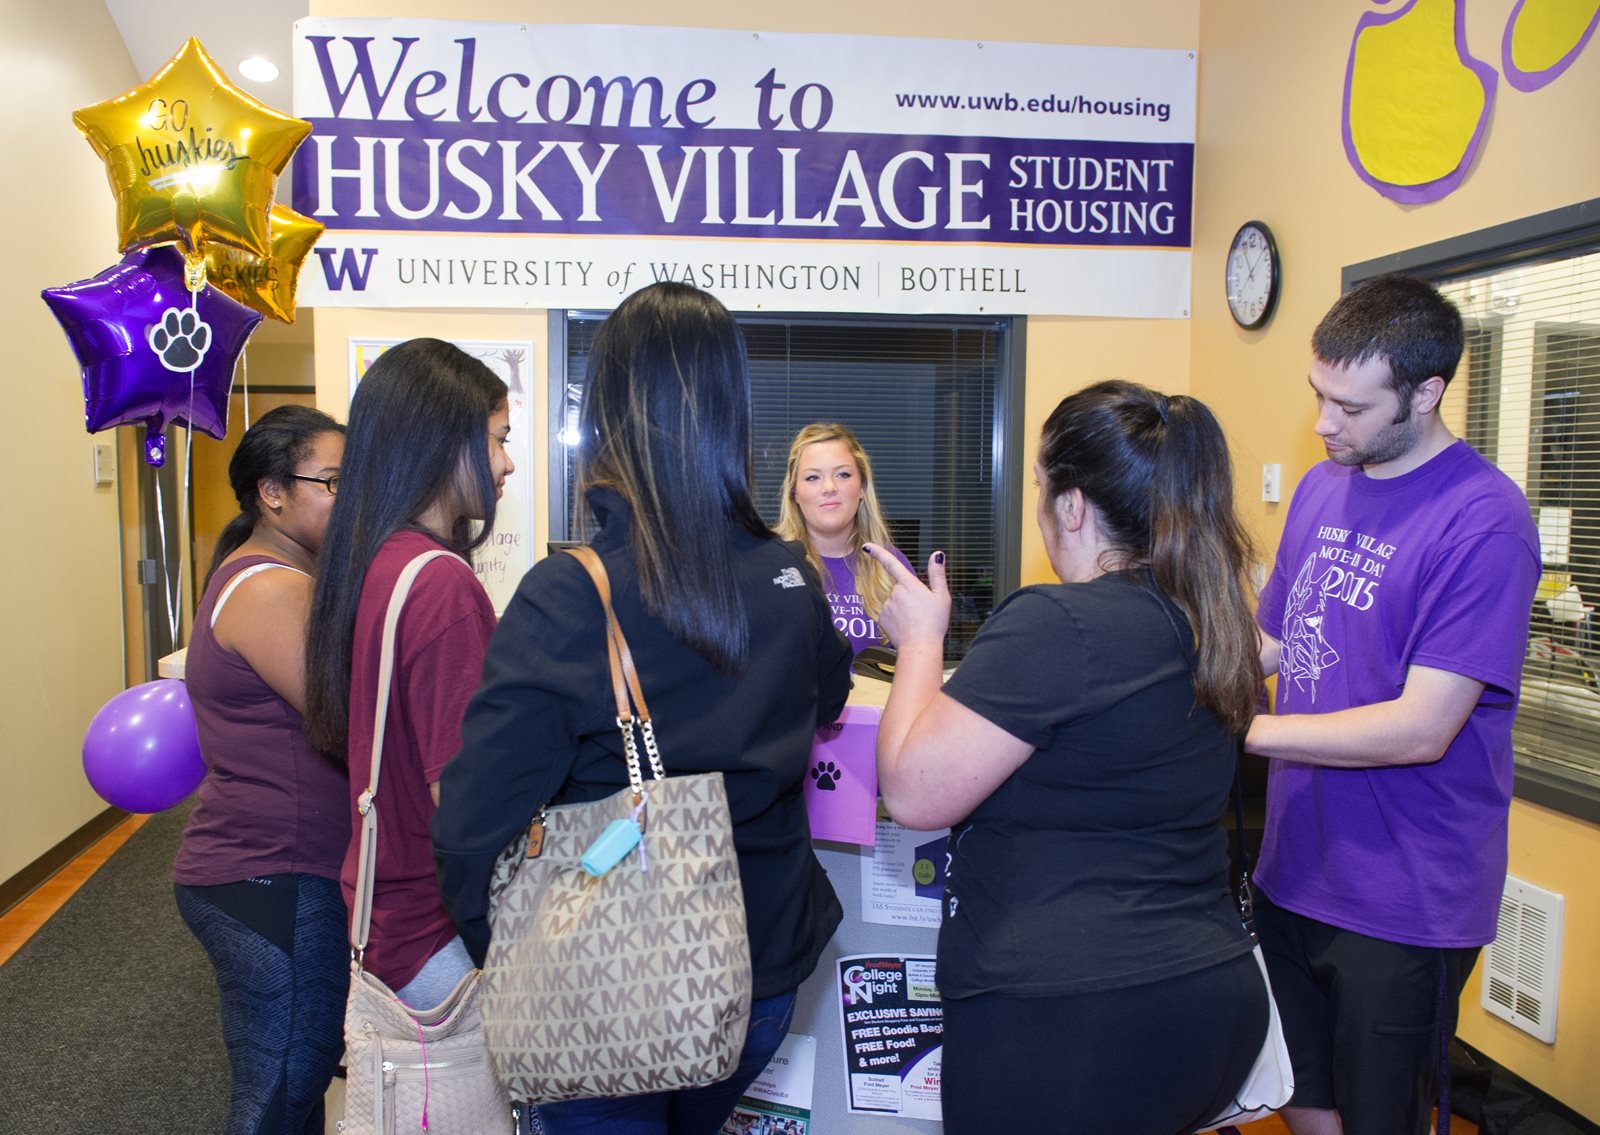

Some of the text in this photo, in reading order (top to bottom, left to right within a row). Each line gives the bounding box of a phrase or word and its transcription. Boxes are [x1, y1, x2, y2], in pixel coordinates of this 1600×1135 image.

[305, 36, 834, 131] Welcome to
[148, 99, 188, 132] GO
[895, 92, 1171, 121] www.uwb.edu/housing
[136, 127, 249, 176] huskies
[311, 135, 991, 229] HUSKY VILLAGE
[1008, 155, 1174, 192] STUDENT
[1008, 199, 1176, 236] HOUSING
[314, 248, 378, 291] W
[397, 258, 1027, 294] UNIVERSITY of WASHINGTON BOTHELL
[485, 529, 521, 556] lage
[1317, 525, 1397, 560] HUSKY VILLAGE
[476, 556, 506, 583] unity
[825, 592, 840, 603] KY
[1325, 566, 1380, 611] 2015
[830, 605, 864, 616] VE-IN
[833, 616, 884, 640] 201
[663, 779, 703, 805] MK
[556, 806, 725, 832] MK MK
[659, 835, 701, 859] MK
[601, 869, 640, 899] MK
[578, 902, 616, 932] MK
[620, 893, 658, 924] MK
[660, 888, 701, 917] MK
[558, 933, 596, 962] MK
[600, 926, 639, 956] MK
[642, 919, 680, 948] MK
[683, 915, 724, 943] MK
[542, 965, 575, 992] MK
[577, 959, 619, 989] MK
[620, 951, 660, 982] MK
[662, 946, 705, 976] MK
[530, 971, 729, 1021] MK MK MK MK MK
[512, 1023, 544, 1049] MK
[545, 1021, 583, 1048] MK
[583, 1017, 622, 1045] MK
[623, 1011, 662, 1041] MK
[664, 1004, 709, 1035] MK
[847, 1008, 907, 1023] EXCLUSIVE
[851, 1023, 944, 1039] FREE Goodie Bag!
[501, 1052, 532, 1073] MK
[530, 1051, 567, 1075] MK
[567, 1048, 608, 1074] MK
[607, 1043, 648, 1070] MK
[648, 1037, 691, 1065] MK
[855, 1037, 916, 1054] FREE Food!
[858, 1053, 901, 1068] & more!
[519, 1076, 559, 1095] MK
[592, 1072, 635, 1094] MK
[631, 1067, 676, 1091] MK
[673, 1059, 714, 1083] MK
